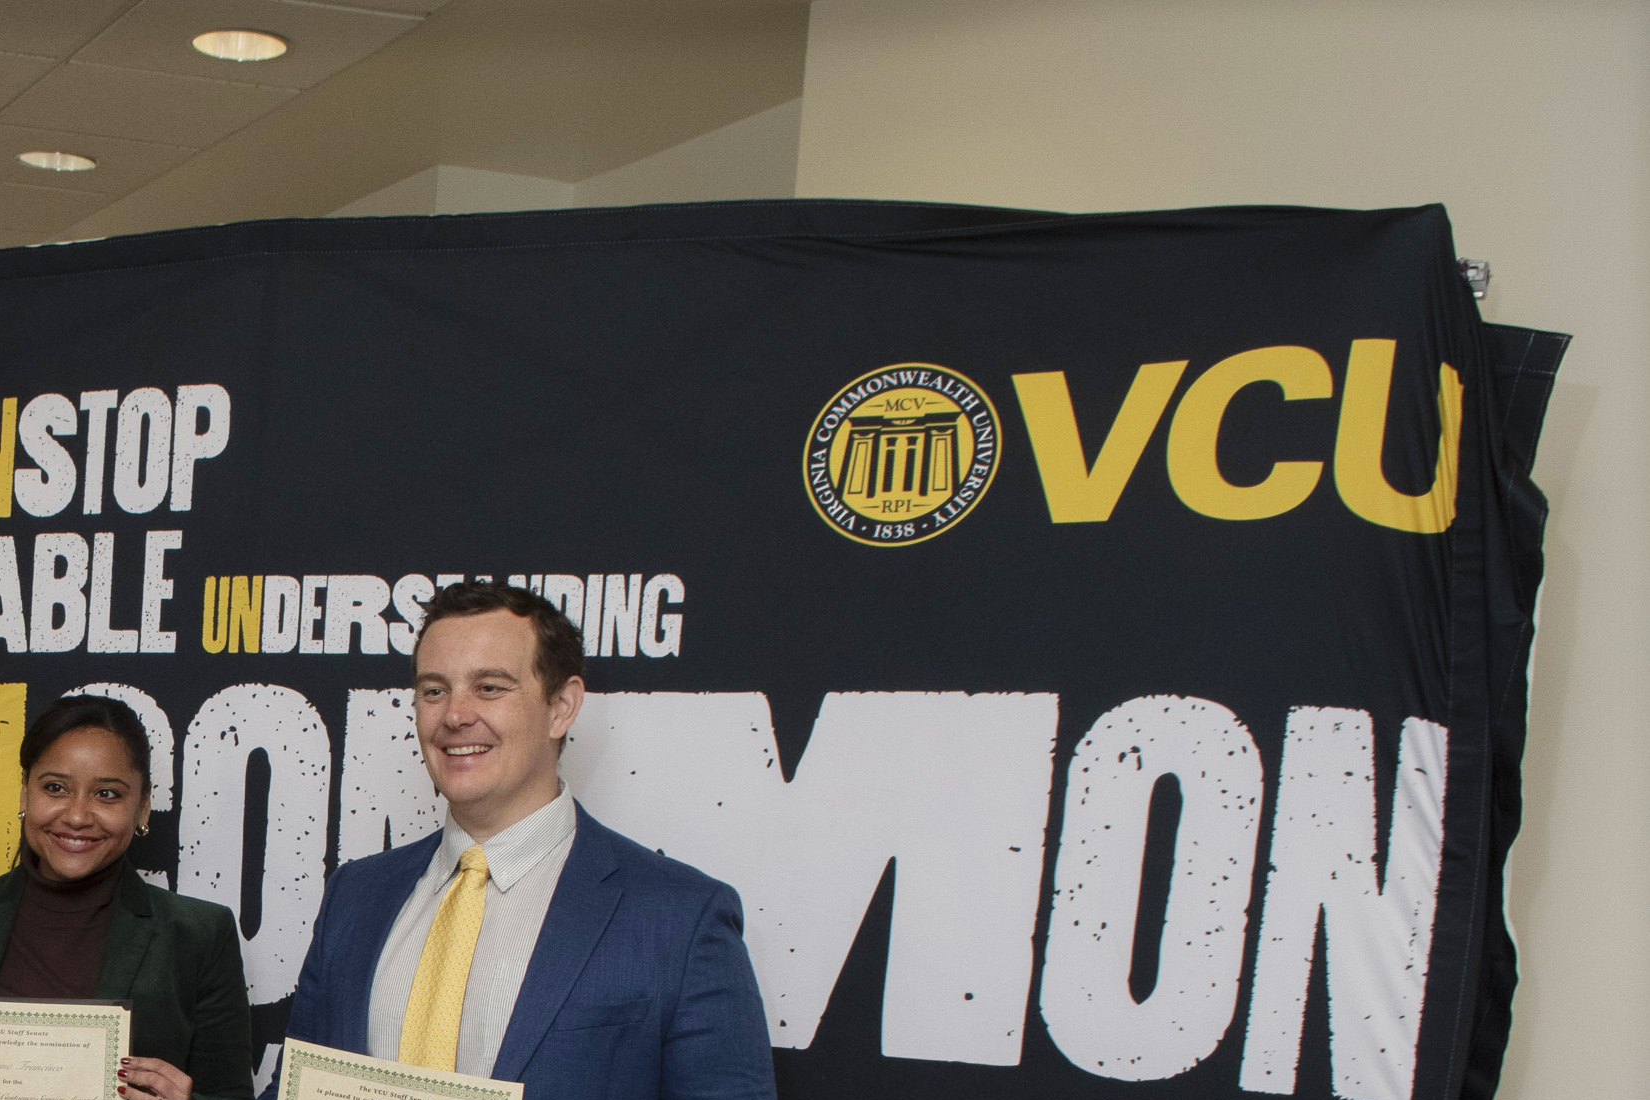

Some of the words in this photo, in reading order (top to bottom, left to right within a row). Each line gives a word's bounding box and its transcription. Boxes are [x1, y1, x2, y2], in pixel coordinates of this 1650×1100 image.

[816, 370, 980, 443] COMMONWEALTH
[884, 397, 926, 412] MCV
[1011, 338, 1464, 534] VCU
[933, 410, 993, 527] UNIVERSITY
[811, 448, 856, 530] VIRGINIA
[881, 499, 913, 514] RPI
[872, 522, 915, 539] 1838
[202, 573, 685, 658] UNDERSDING
[7, 1028, 24, 1036] Staff
[15, 1060, 64, 1072] Francisco
[324, 1090, 351, 1100] pleased
[359, 1085, 372, 1093] The
[374, 1088, 388, 1096] VCU
[390, 1091, 408, 1100] Staff
